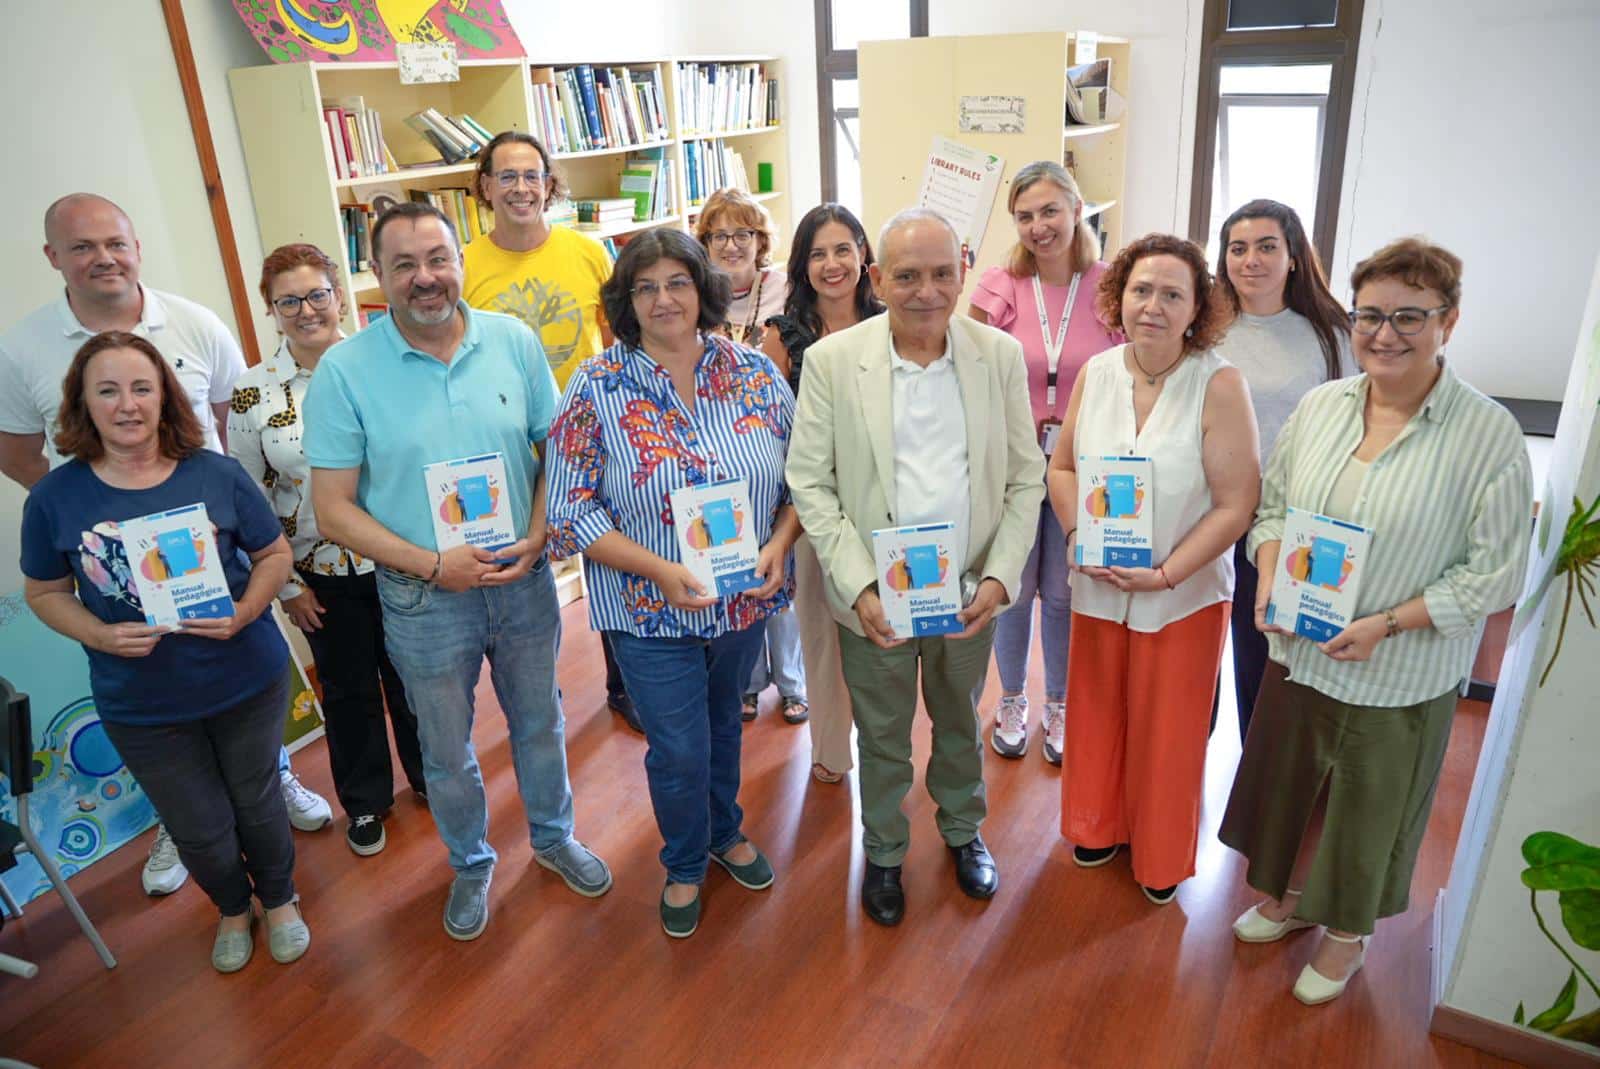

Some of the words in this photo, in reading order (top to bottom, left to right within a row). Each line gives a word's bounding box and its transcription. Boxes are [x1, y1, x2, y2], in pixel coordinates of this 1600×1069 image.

[931, 156, 959, 171] LIBRARY
[960, 167, 982, 181] RULES
[464, 527, 494, 540] Manual
[1103, 528, 1134, 536] Manual
[711, 552, 740, 564] Manual
[171, 582, 205, 596] Manual
[910, 597, 941, 606] Manual
[1300, 592, 1332, 608] Manual
